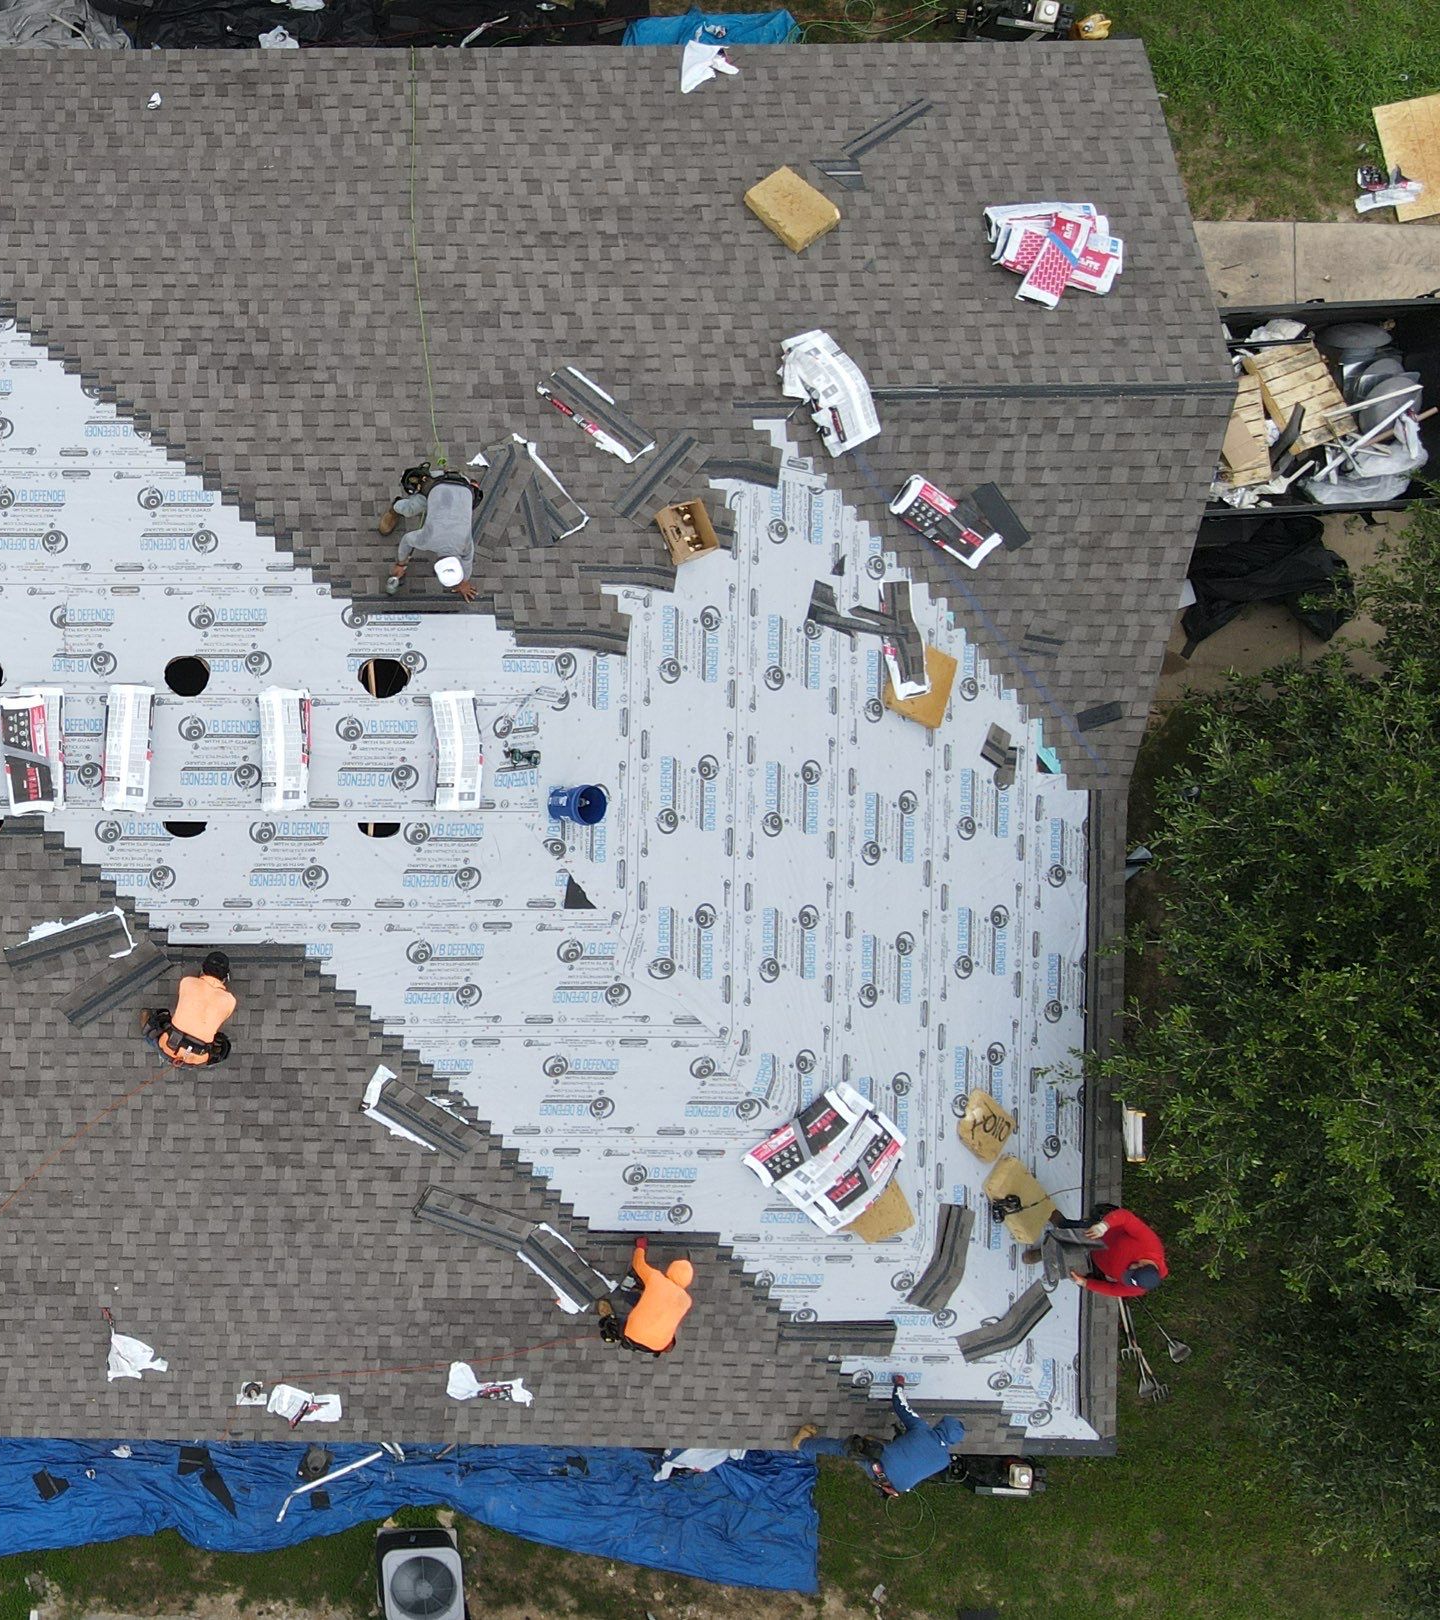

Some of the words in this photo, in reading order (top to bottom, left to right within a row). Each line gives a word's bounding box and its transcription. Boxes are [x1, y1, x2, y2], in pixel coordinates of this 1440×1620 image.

[29, 490, 65, 501] DEFENDER
[140, 538, 177, 551] DEFENDER
[230, 608, 267, 621] DEFENDER
[662, 605, 673, 642] DEFENDER
[767, 615, 778, 651] DEFENDER
[707, 646, 718, 683] DEFENDER
[379, 720, 418, 733] DEFENDER
[27, 768, 38, 800] TITAN
[338, 773, 376, 787] DEFENDER
[660, 756, 671, 793] DEFENDER
[765, 761, 776, 797] DEFENDER
[960, 769, 970, 803] DEFENDER
[705, 795, 716, 831] DEFENDER
[808, 799, 818, 834] DEFENDER
[864, 793, 874, 827] DEFENDER
[291, 823, 329, 835] DEFENDER
[904, 829, 915, 863] DEFENDER
[1050, 818, 1060, 851] DEFENDER
[249, 874, 287, 886] DEFENDER
[402, 875, 439, 887] DEFENDER
[762, 907, 773, 943] DEFENDER
[957, 908, 967, 942] DEFENDER
[447, 943, 484, 956] DEFENDER
[702, 943, 713, 979] DEFENDER
[805, 944, 816, 979] DEFENDER
[861, 935, 872, 969] DEFENDER
[996, 942, 1007, 976] DEFENDER
